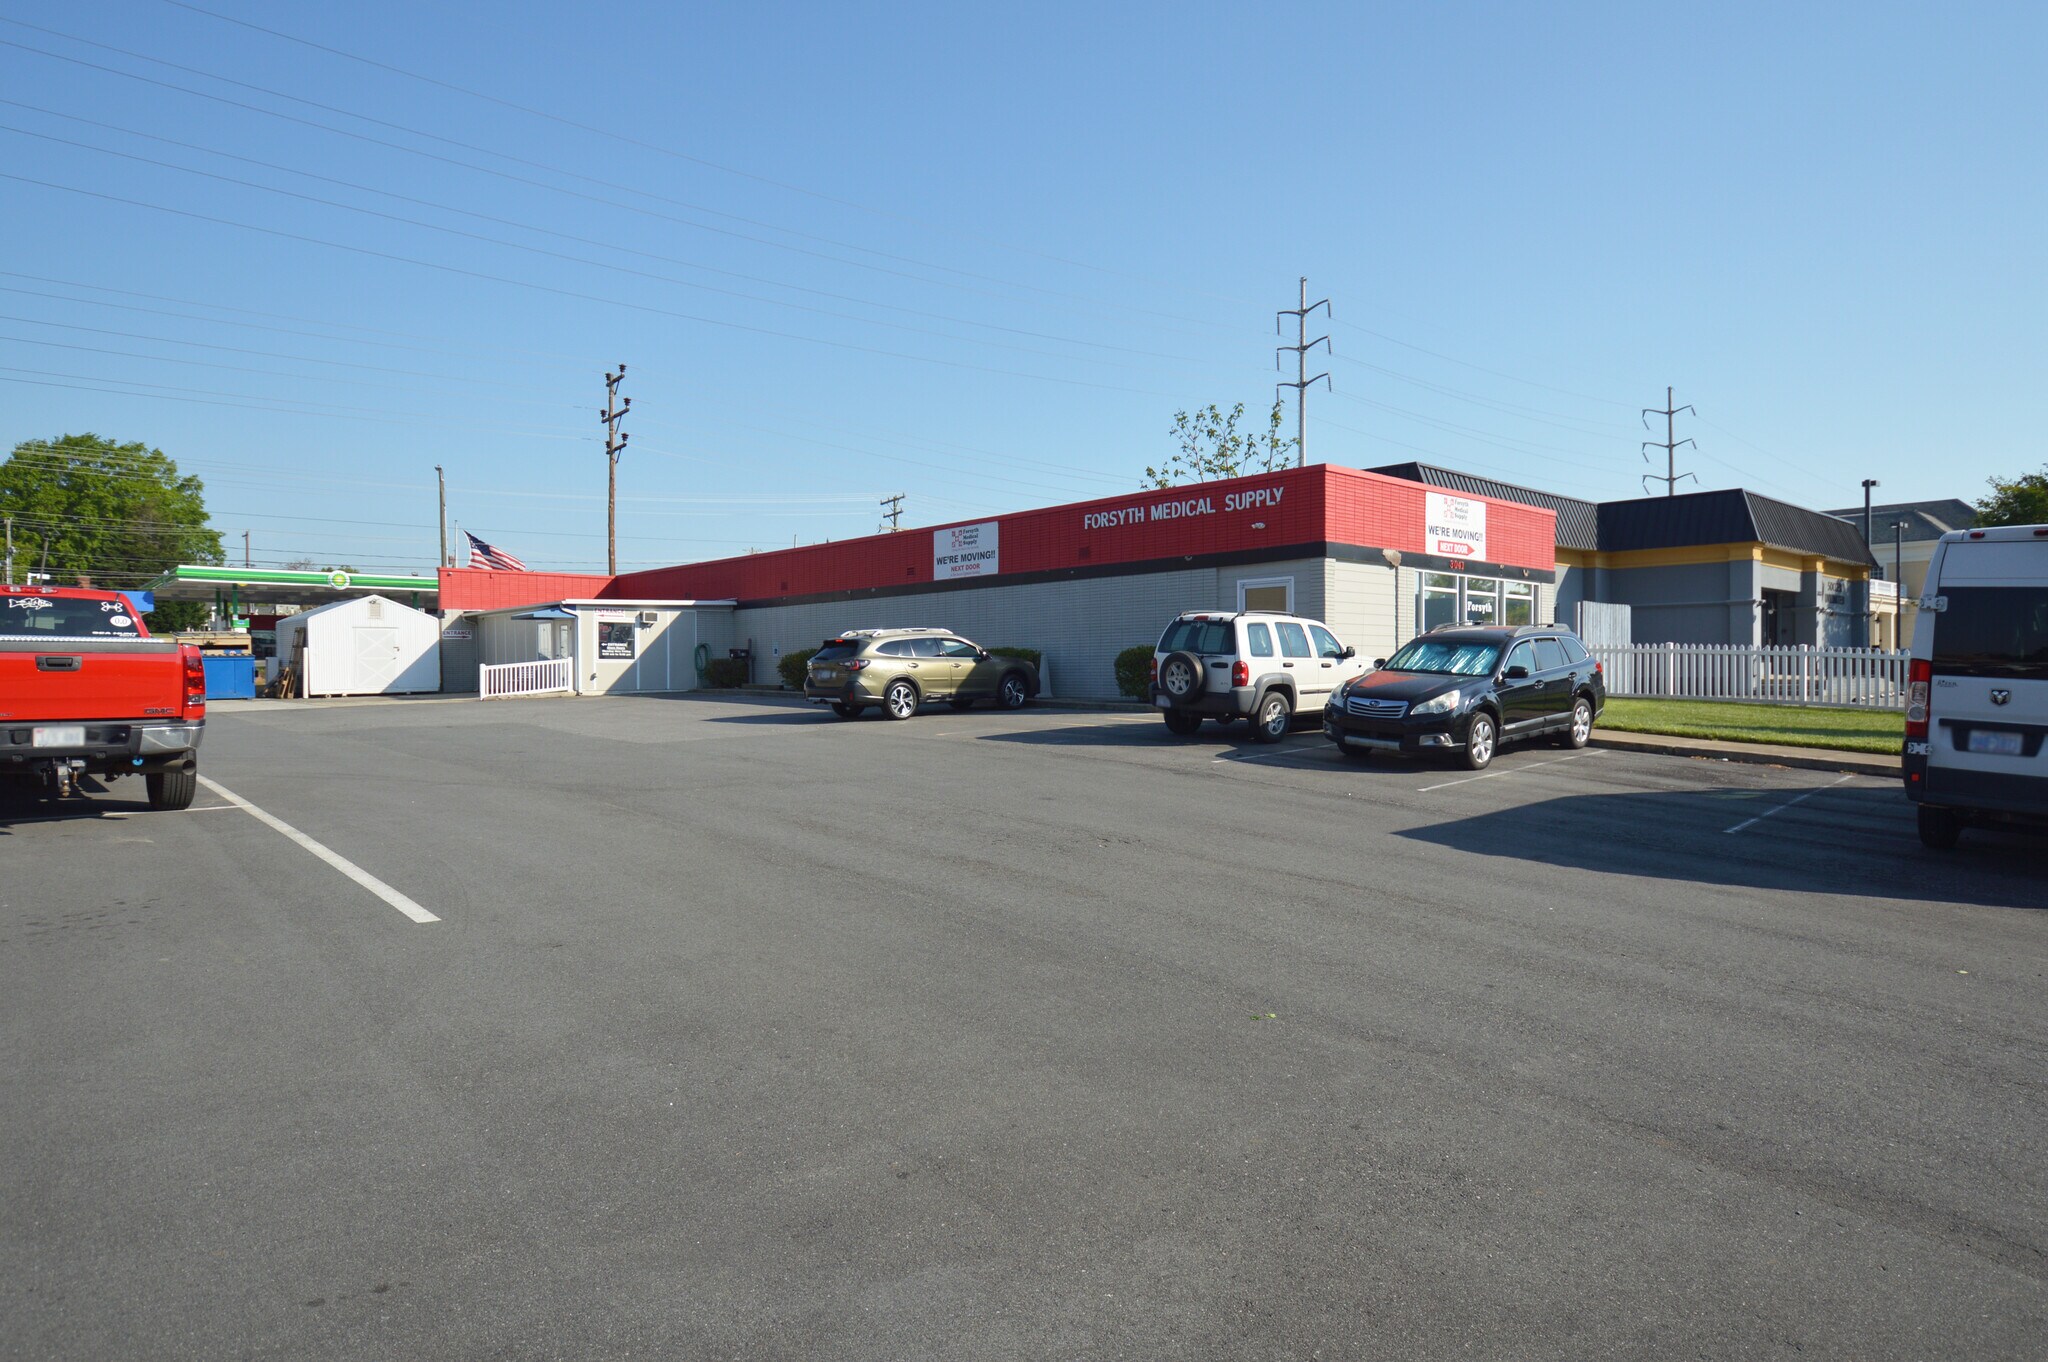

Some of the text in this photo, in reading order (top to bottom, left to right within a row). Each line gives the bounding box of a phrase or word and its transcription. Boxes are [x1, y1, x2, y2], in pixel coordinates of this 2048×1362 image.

[1084, 486, 1285, 530] FORSYTH MEDICAL SUPPLY
[1428, 524, 1450, 538] WE'RE
[1440, 542, 1468, 555] NEXT DOOR
[936, 555, 959, 565] WE'RE
[951, 564, 964, 572] NEXT
[1467, 601, 1493, 614] Forsyth
[114, 617, 128, 625] 0.0
